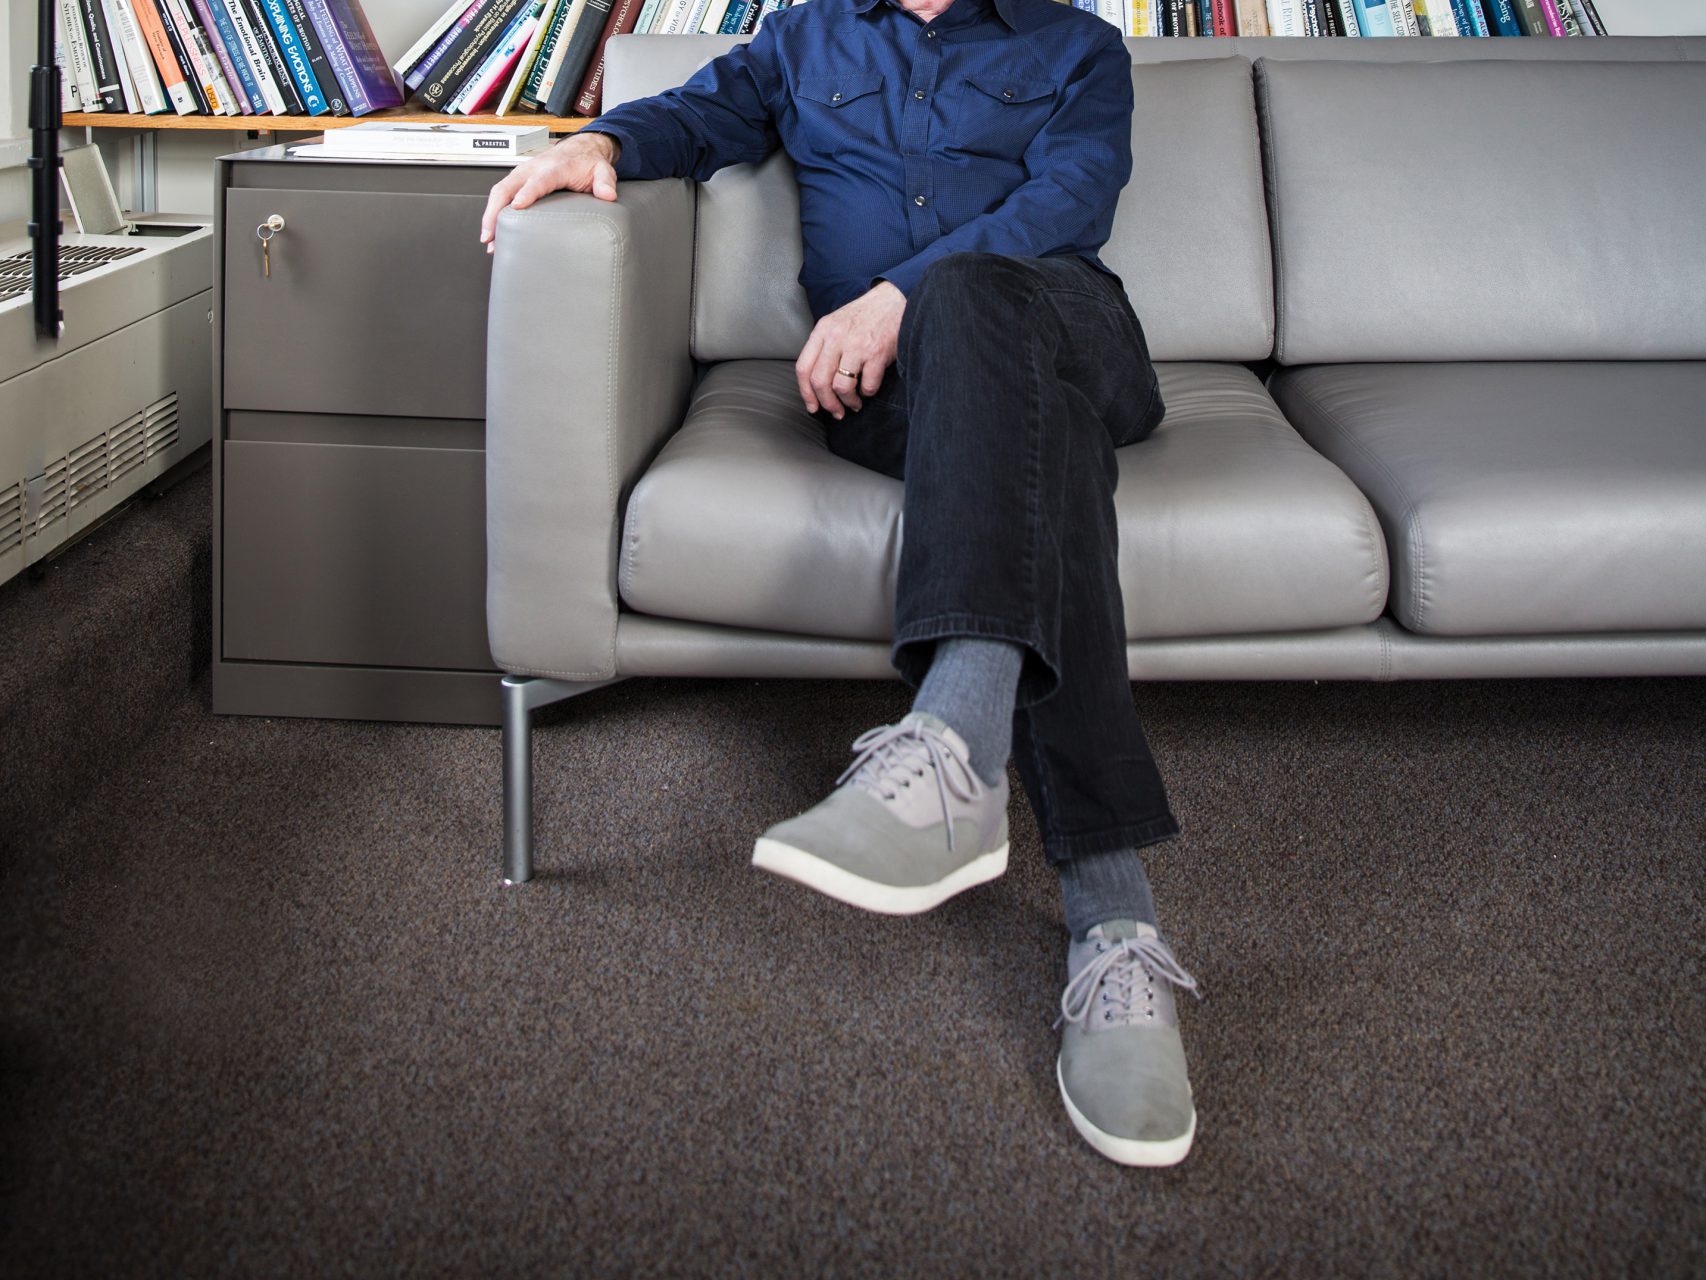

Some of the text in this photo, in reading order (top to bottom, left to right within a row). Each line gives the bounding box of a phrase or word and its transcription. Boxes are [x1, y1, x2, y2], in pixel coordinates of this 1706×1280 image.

[1405, 2, 1414, 19] Who
[87, 13, 96, 30] Qualia,
[95, 43, 106, 79] Consciousness
[174, 12, 205, 76] HELPLESSNESS
[228, 0, 266, 81] The Emotional Brain
[424, 27, 462, 70] DAVID PERRETT
[288, 46, 313, 92] EMOTIONS
[533, 55, 549, 89] Error
